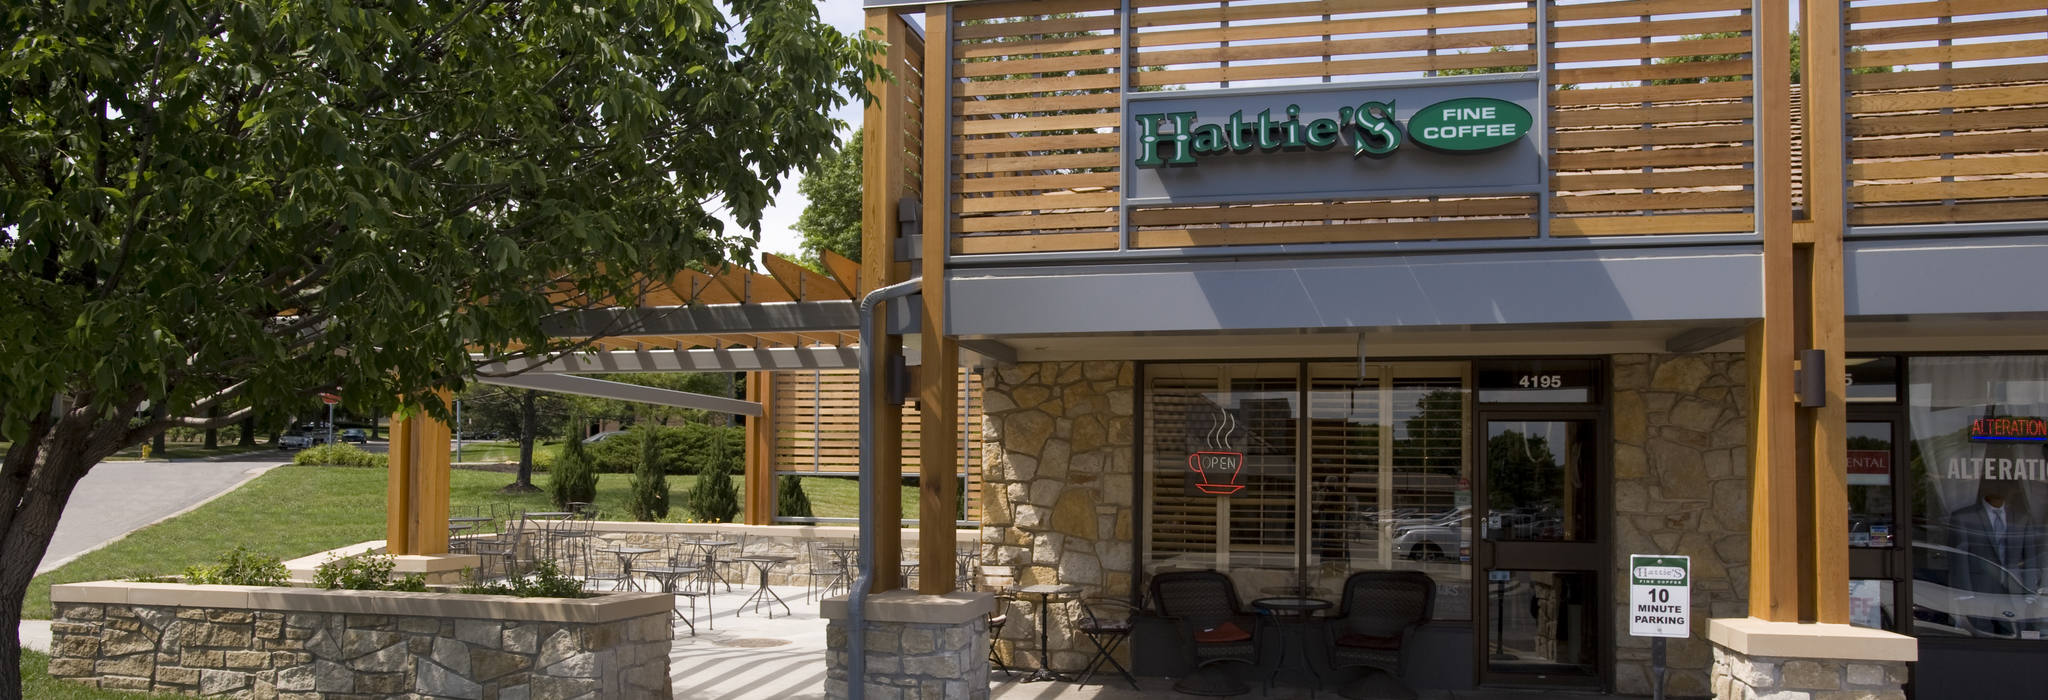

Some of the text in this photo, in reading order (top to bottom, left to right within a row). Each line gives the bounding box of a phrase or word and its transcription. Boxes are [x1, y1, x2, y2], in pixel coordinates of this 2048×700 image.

[1443, 107, 1496, 121] FINE
[1423, 123, 1516, 139] COFFEE
[1519, 375, 1562, 388] 4195
[1203, 456, 1236, 470] OPEN
[1947, 457, 2048, 481] ALTERATI
[1648, 588, 1669, 603] 10
[1638, 604, 1682, 613] MINUTE
[1635, 615, 1685, 625] PARKING
